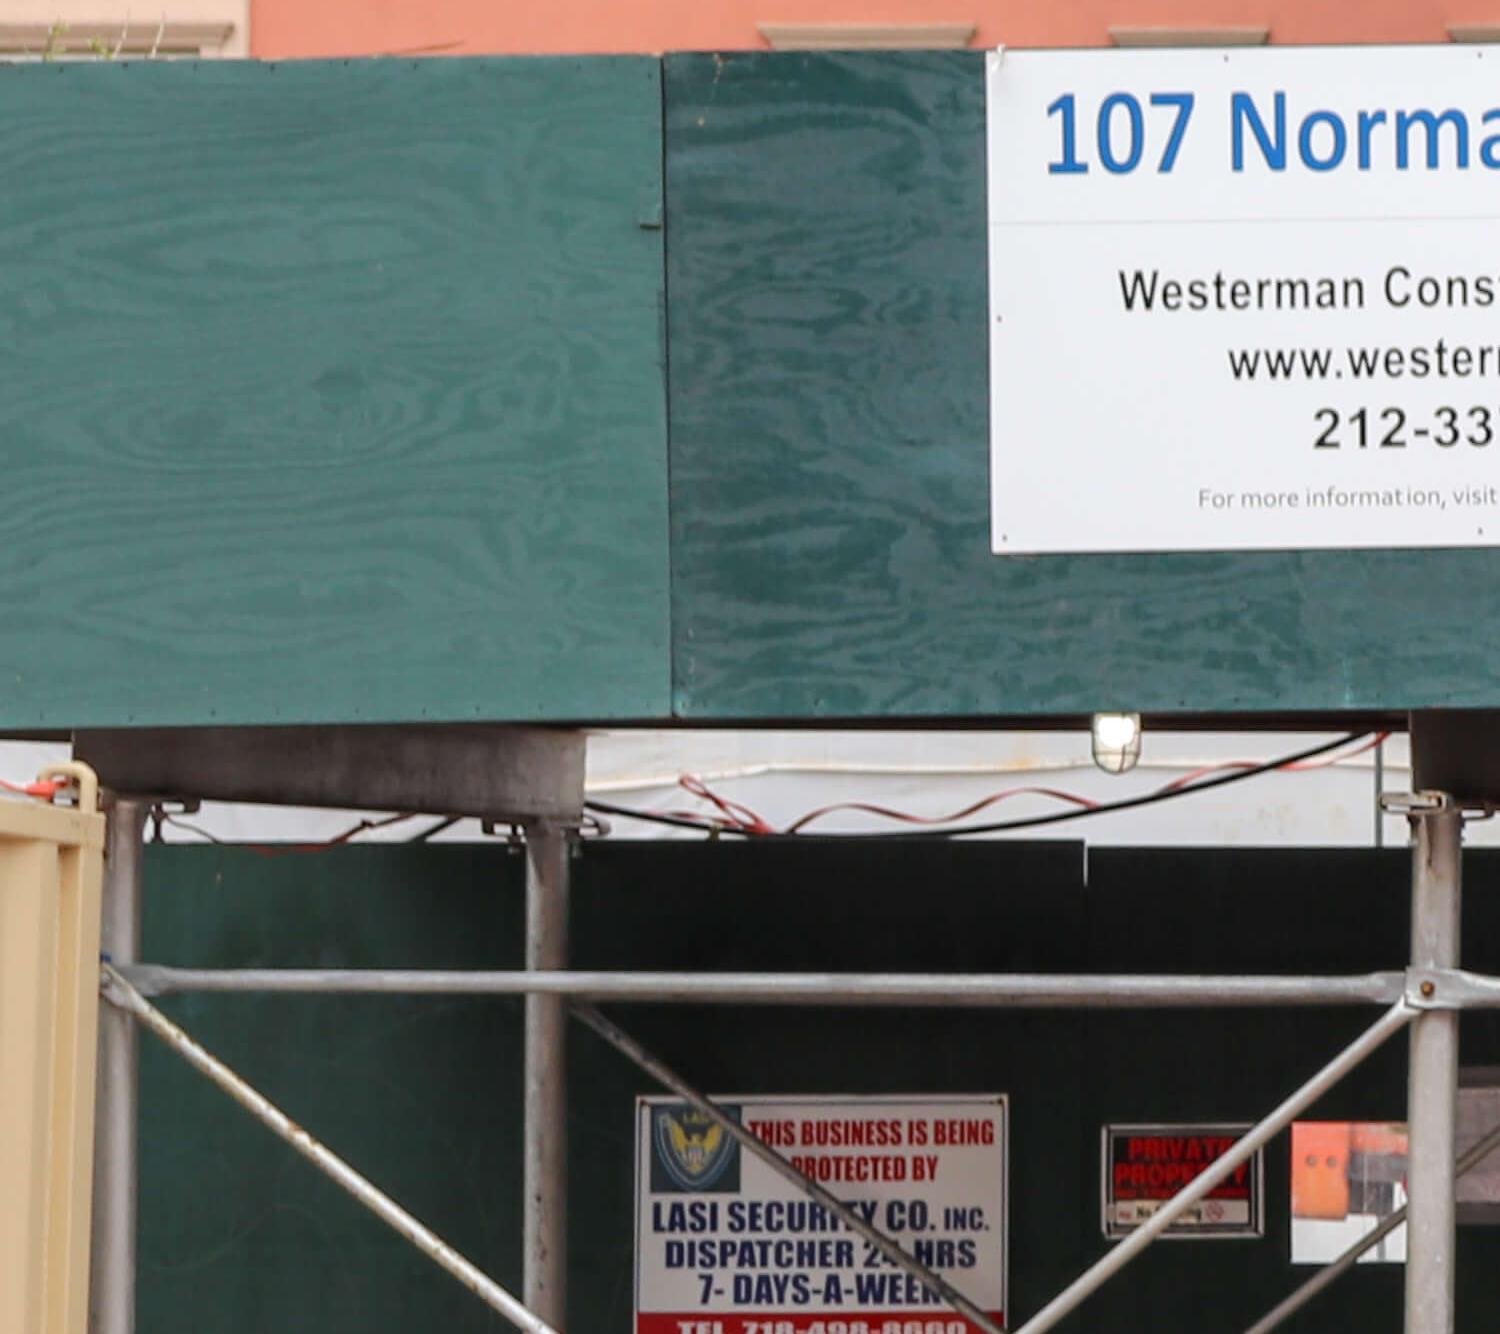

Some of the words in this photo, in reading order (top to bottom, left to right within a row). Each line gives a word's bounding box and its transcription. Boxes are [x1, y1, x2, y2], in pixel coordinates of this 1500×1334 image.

[1047, 92, 1195, 175] 107
[1119, 270, 1364, 311] Westerman
[1198, 488, 1231, 508] For
[1240, 492, 1298, 508] more
[1305, 487, 1446, 511] information,
[1454, 486, 1496, 507] visit
[800, 1121, 903, 1146] BUSINESS
[907, 1121, 929, 1146] IS
[933, 1121, 995, 1146] BEING
[791, 1156, 907, 1182] PROTECTED
[912, 1156, 939, 1182] BY
[1115, 1162, 1249, 1186] PROPEY
[652, 1202, 720, 1232] LASI
[887, 1201, 936, 1231] CO.
[944, 1207, 990, 1231] INC.
[665, 1241, 854, 1268] DISPATCHER
